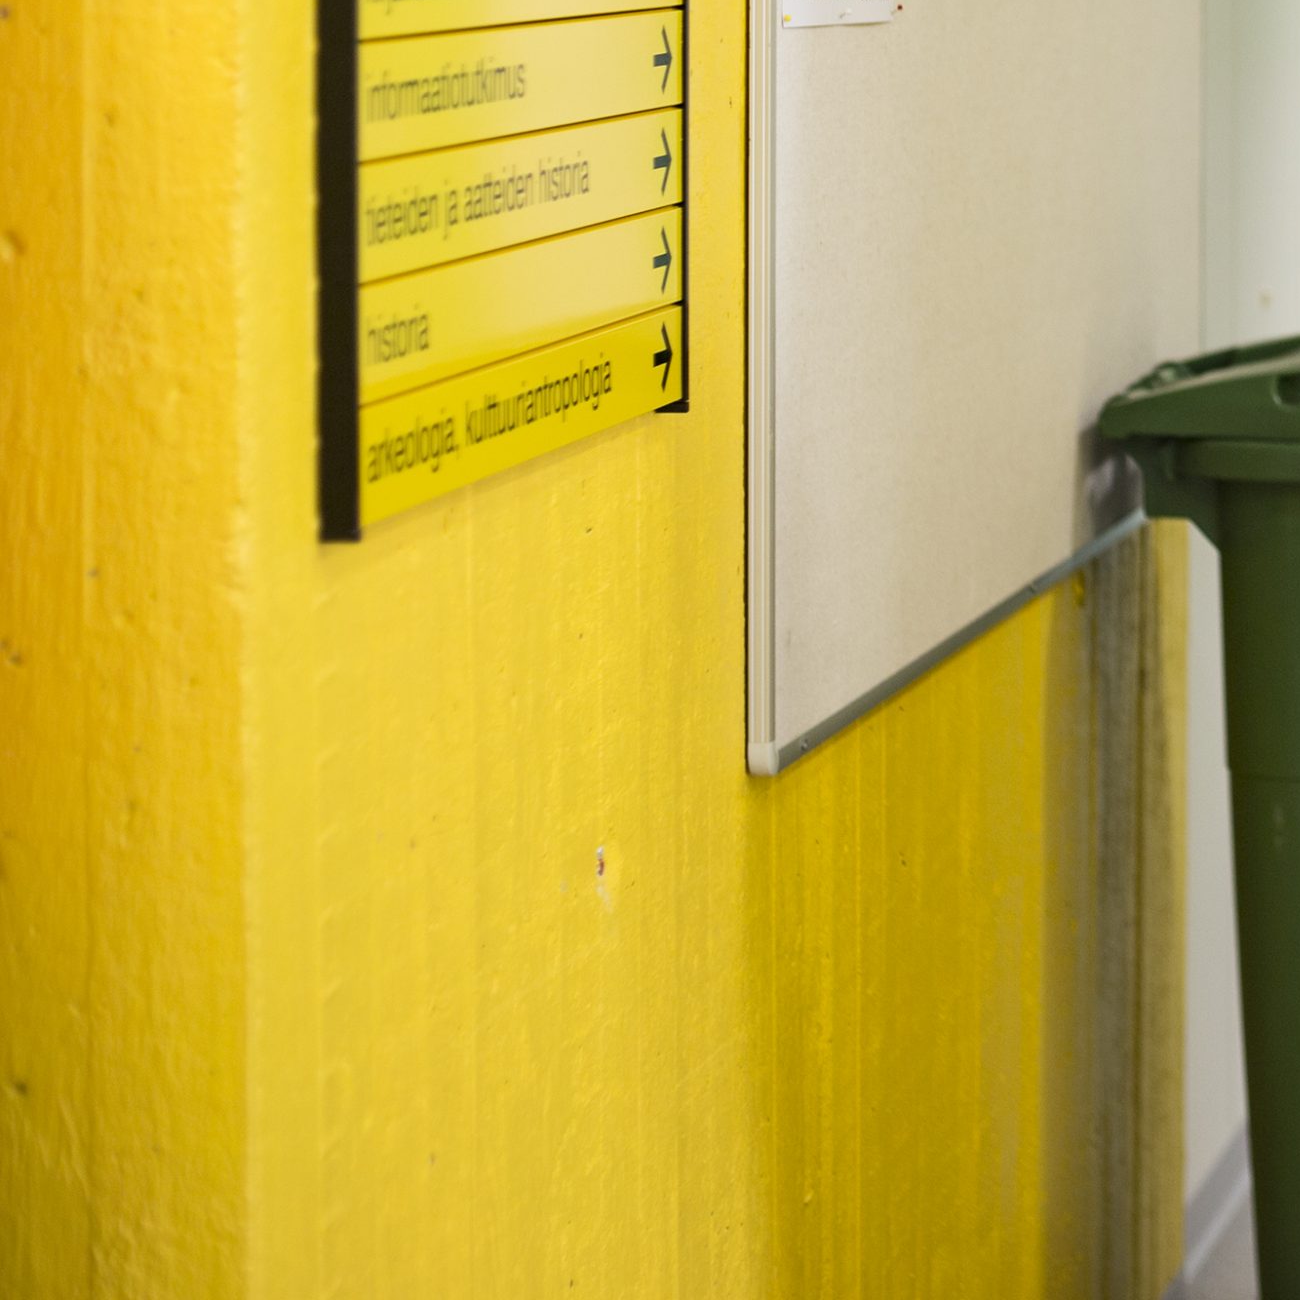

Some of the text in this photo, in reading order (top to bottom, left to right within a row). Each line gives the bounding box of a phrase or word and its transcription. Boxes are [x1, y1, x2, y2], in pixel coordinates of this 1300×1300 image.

[365, 57, 526, 124] informaatiotutkimus
[364, 152, 590, 248] tieteiden ja aatteiden historia
[364, 305, 430, 366] historia
[366, 354, 613, 484] arkeologia, kulttuuriantropologia
